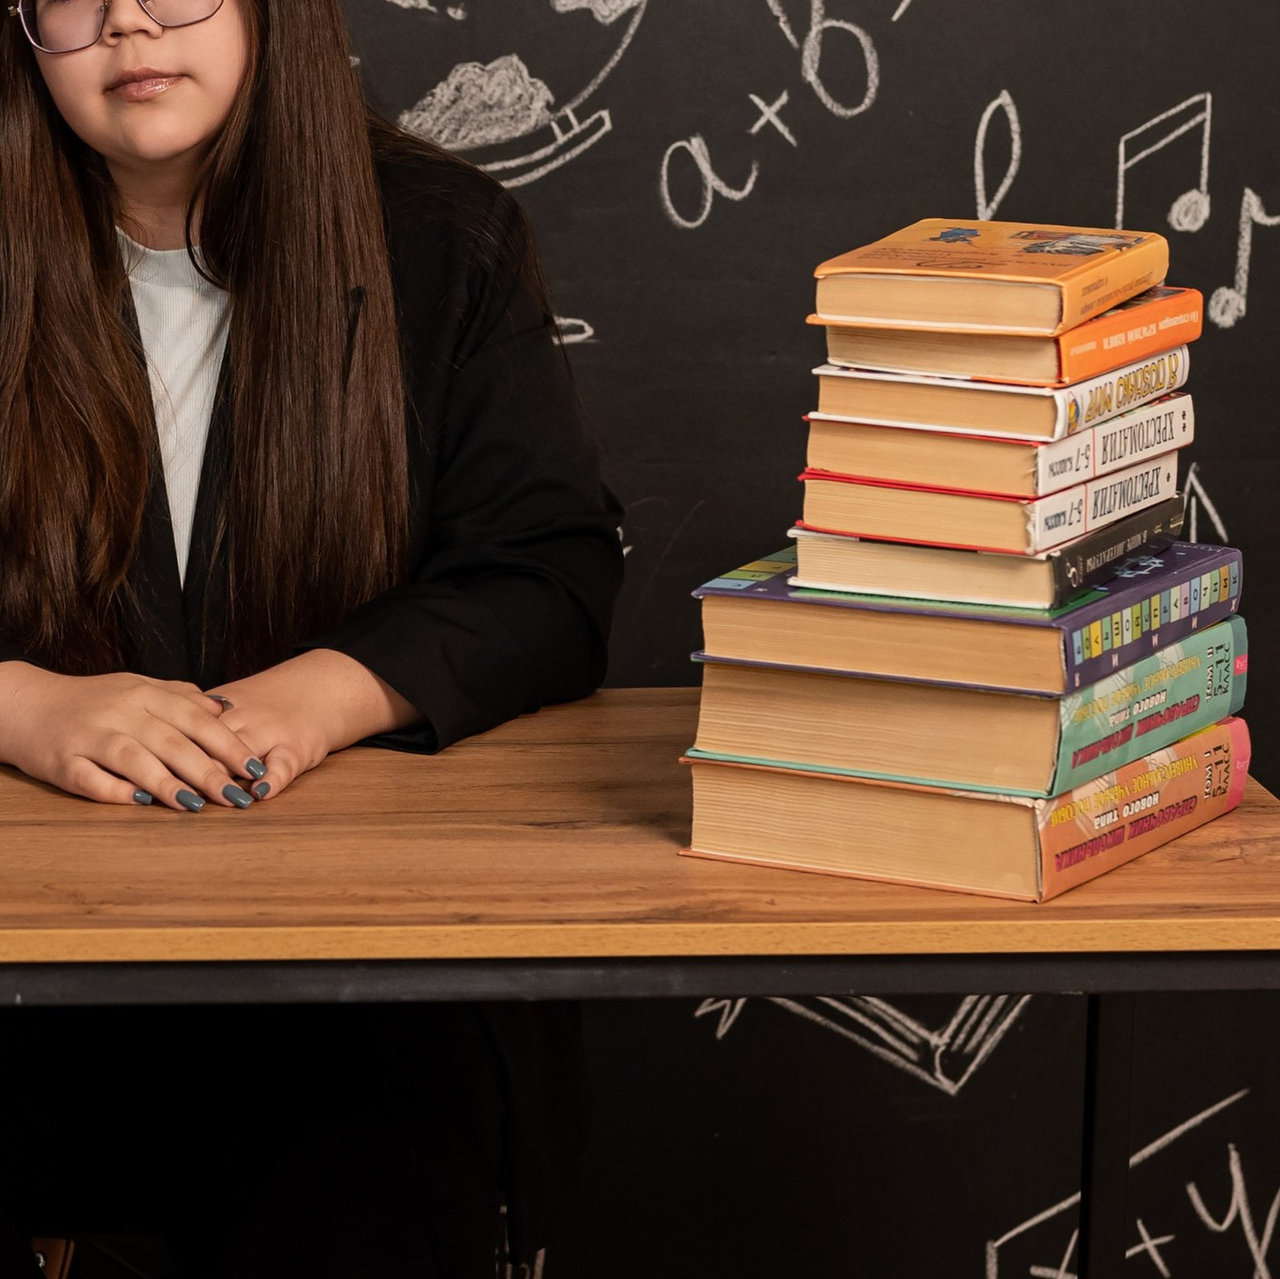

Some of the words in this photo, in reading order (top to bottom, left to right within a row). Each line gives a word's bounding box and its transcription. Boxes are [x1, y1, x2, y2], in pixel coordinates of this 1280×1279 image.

[1116, 358, 1166, 407] ПОЗНАЮ
[1101, 412, 1175, 465] ХРЕСТОМАТИЯ
[1092, 467, 1161, 520] ХРЕСТОМАТИЯ
